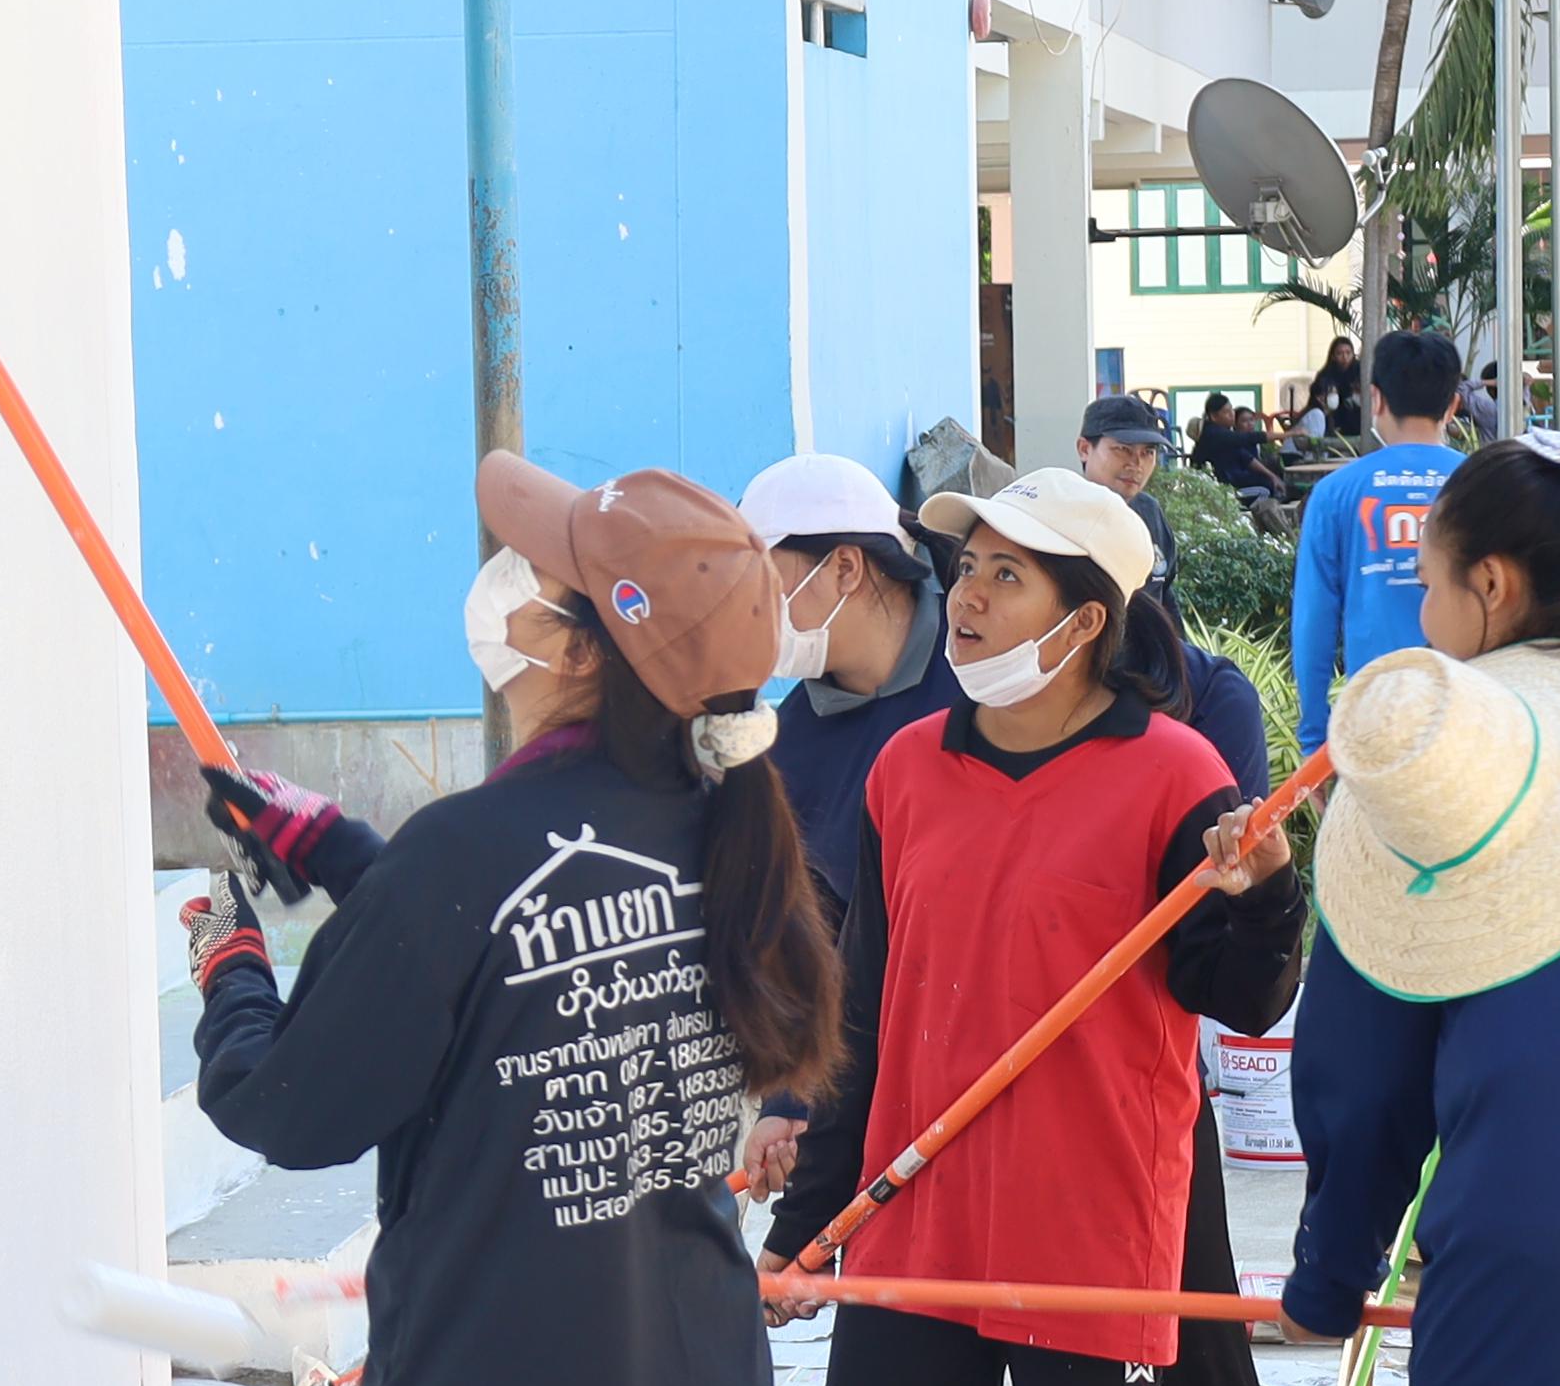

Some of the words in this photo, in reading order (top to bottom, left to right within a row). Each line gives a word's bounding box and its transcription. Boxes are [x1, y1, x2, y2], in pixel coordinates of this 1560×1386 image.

[509, 882, 675, 969] ห้าแยก
[1231, 1056, 1277, 1073] SEACO
[545, 1070, 608, 1101] ตาก
[533, 1100, 623, 1135] วังเจ้า
[524, 1132, 630, 1171] สามเงา
[542, 1164, 618, 1199] แม่ปะ
[555, 1189, 635, 1227] แม่สอ
